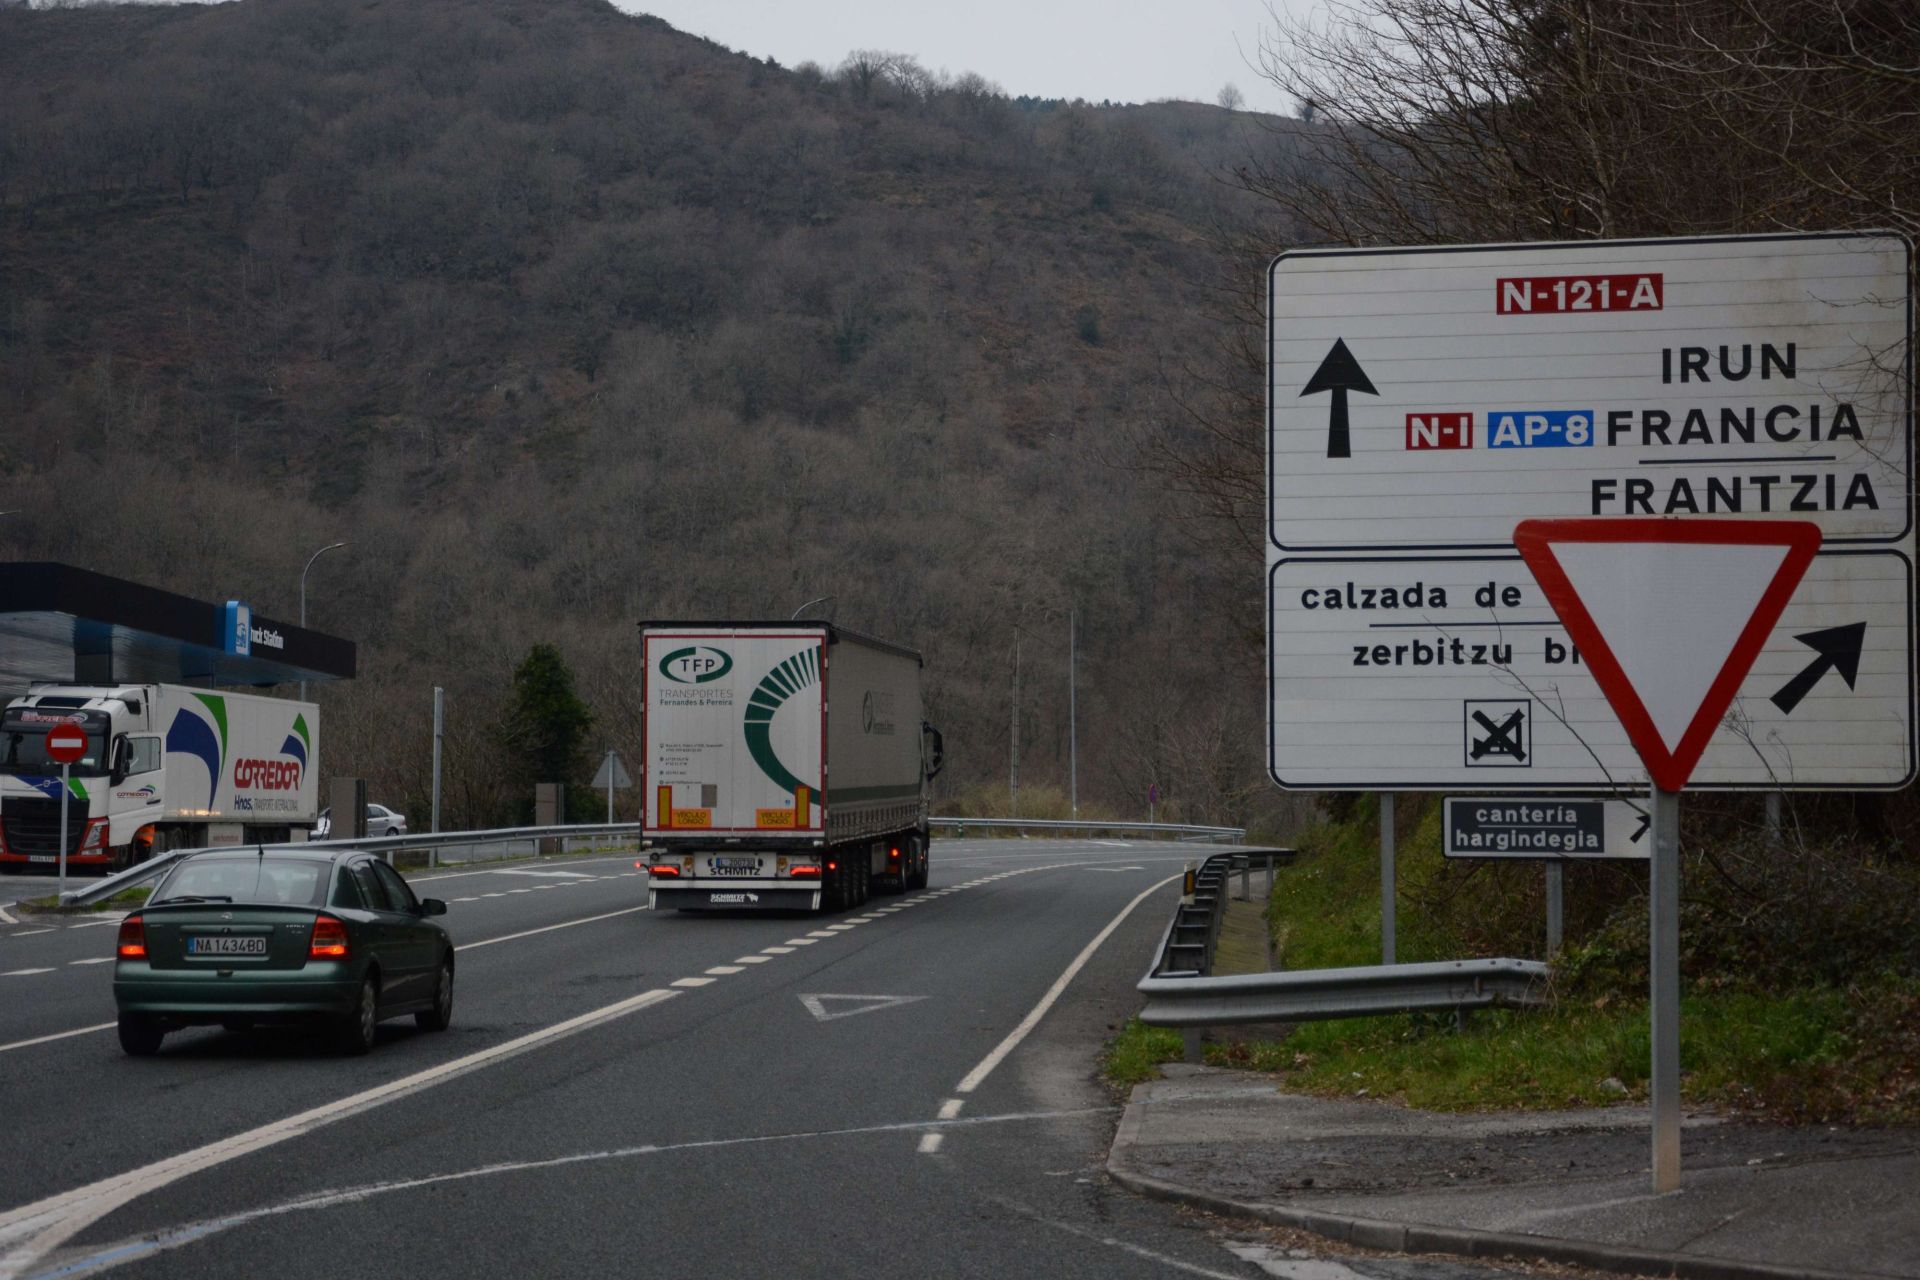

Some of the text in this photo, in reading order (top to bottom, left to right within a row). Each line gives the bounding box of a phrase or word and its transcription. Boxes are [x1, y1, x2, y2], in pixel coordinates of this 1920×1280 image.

[1502, 276, 1660, 312] N-121-A
[1662, 342, 1798, 385] IRUN
[1493, 413, 1591, 448] AP-8
[1607, 402, 1865, 446] FRANCIA
[1591, 473, 1880, 516] FRANTZIA
[1300, 580, 1522, 609] calzada de
[250, 626, 284, 649] ruck Station
[1352, 637, 1513, 666] zerbitzu
[680, 658, 716, 673] TFP
[659, 688, 734, 699] TRANSPORTES
[660, 698, 733, 706] Fernandes & Pereira
[234, 758, 300, 791] CORREDOR
[233, 795, 253, 810] Hnos.
[1475, 804, 1578, 823] cantería
[1455, 829, 1600, 851] hargindegia
[710, 867, 761, 876] SCHMITZ
